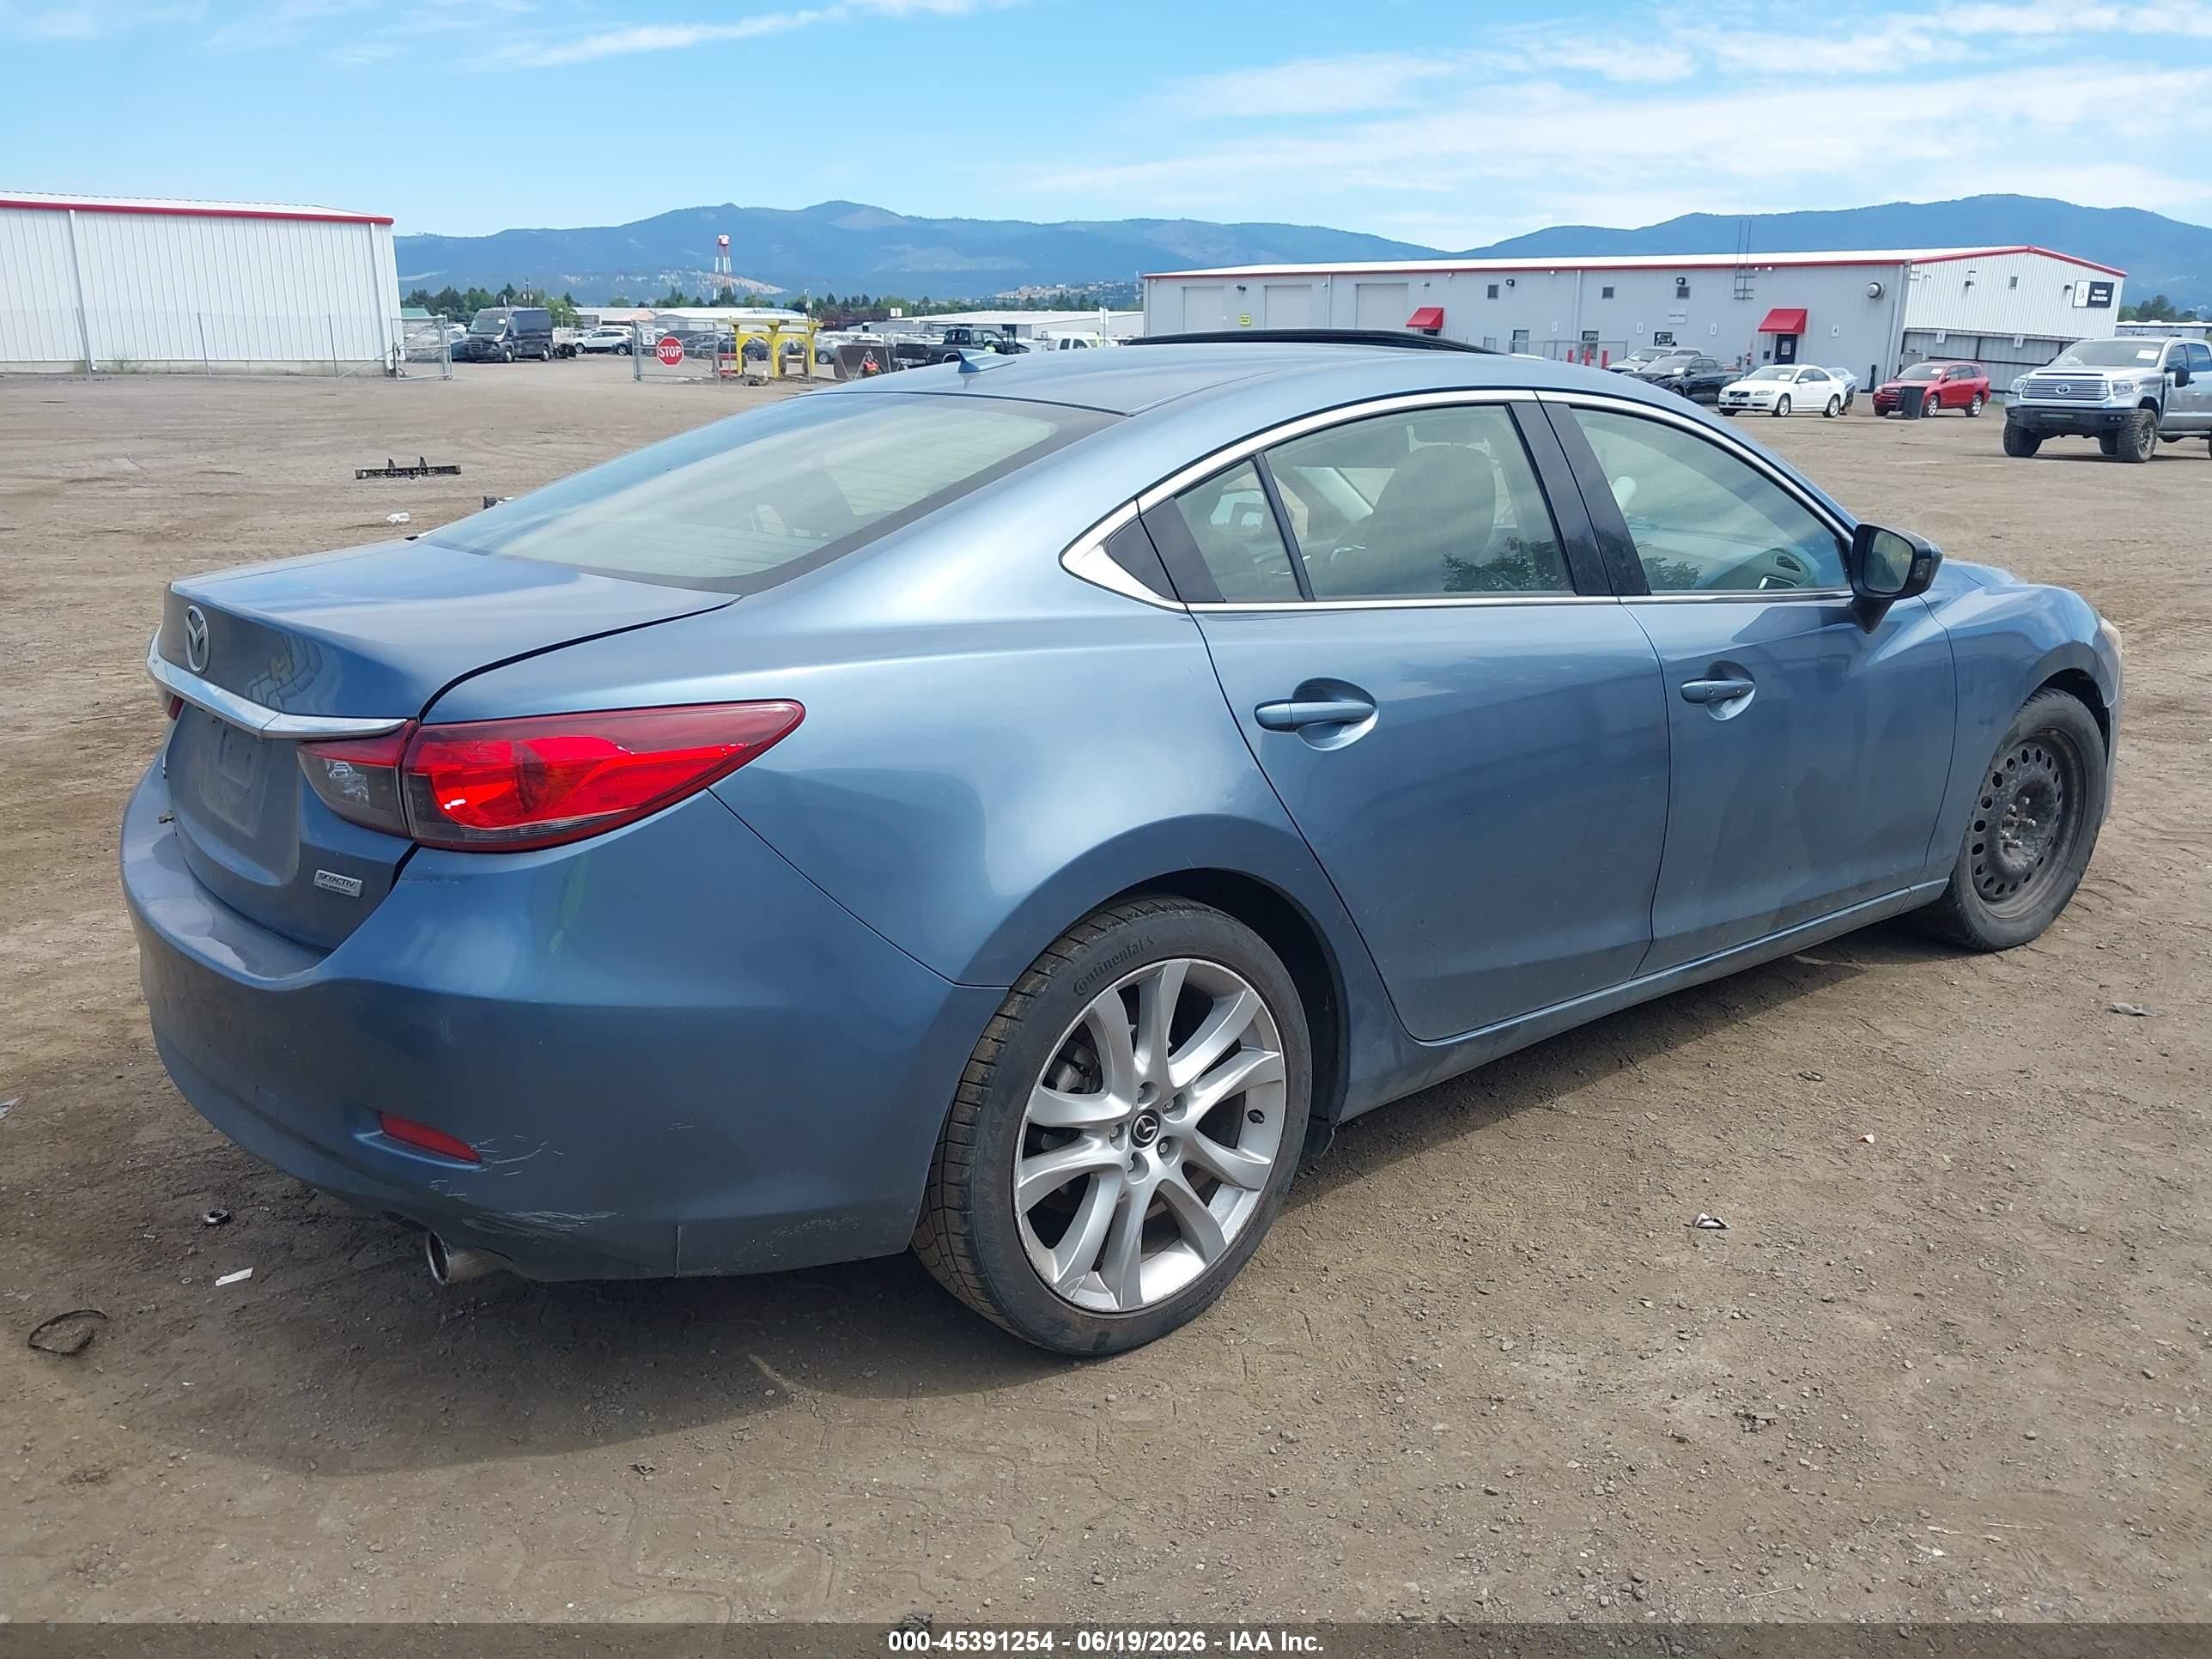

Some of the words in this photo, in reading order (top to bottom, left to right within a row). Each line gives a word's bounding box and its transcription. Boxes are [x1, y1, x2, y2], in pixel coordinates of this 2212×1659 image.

[659, 346, 682, 358] STOP
[318, 872, 359, 887] SKYACTIV
[1073, 939, 1146, 997] Continental
